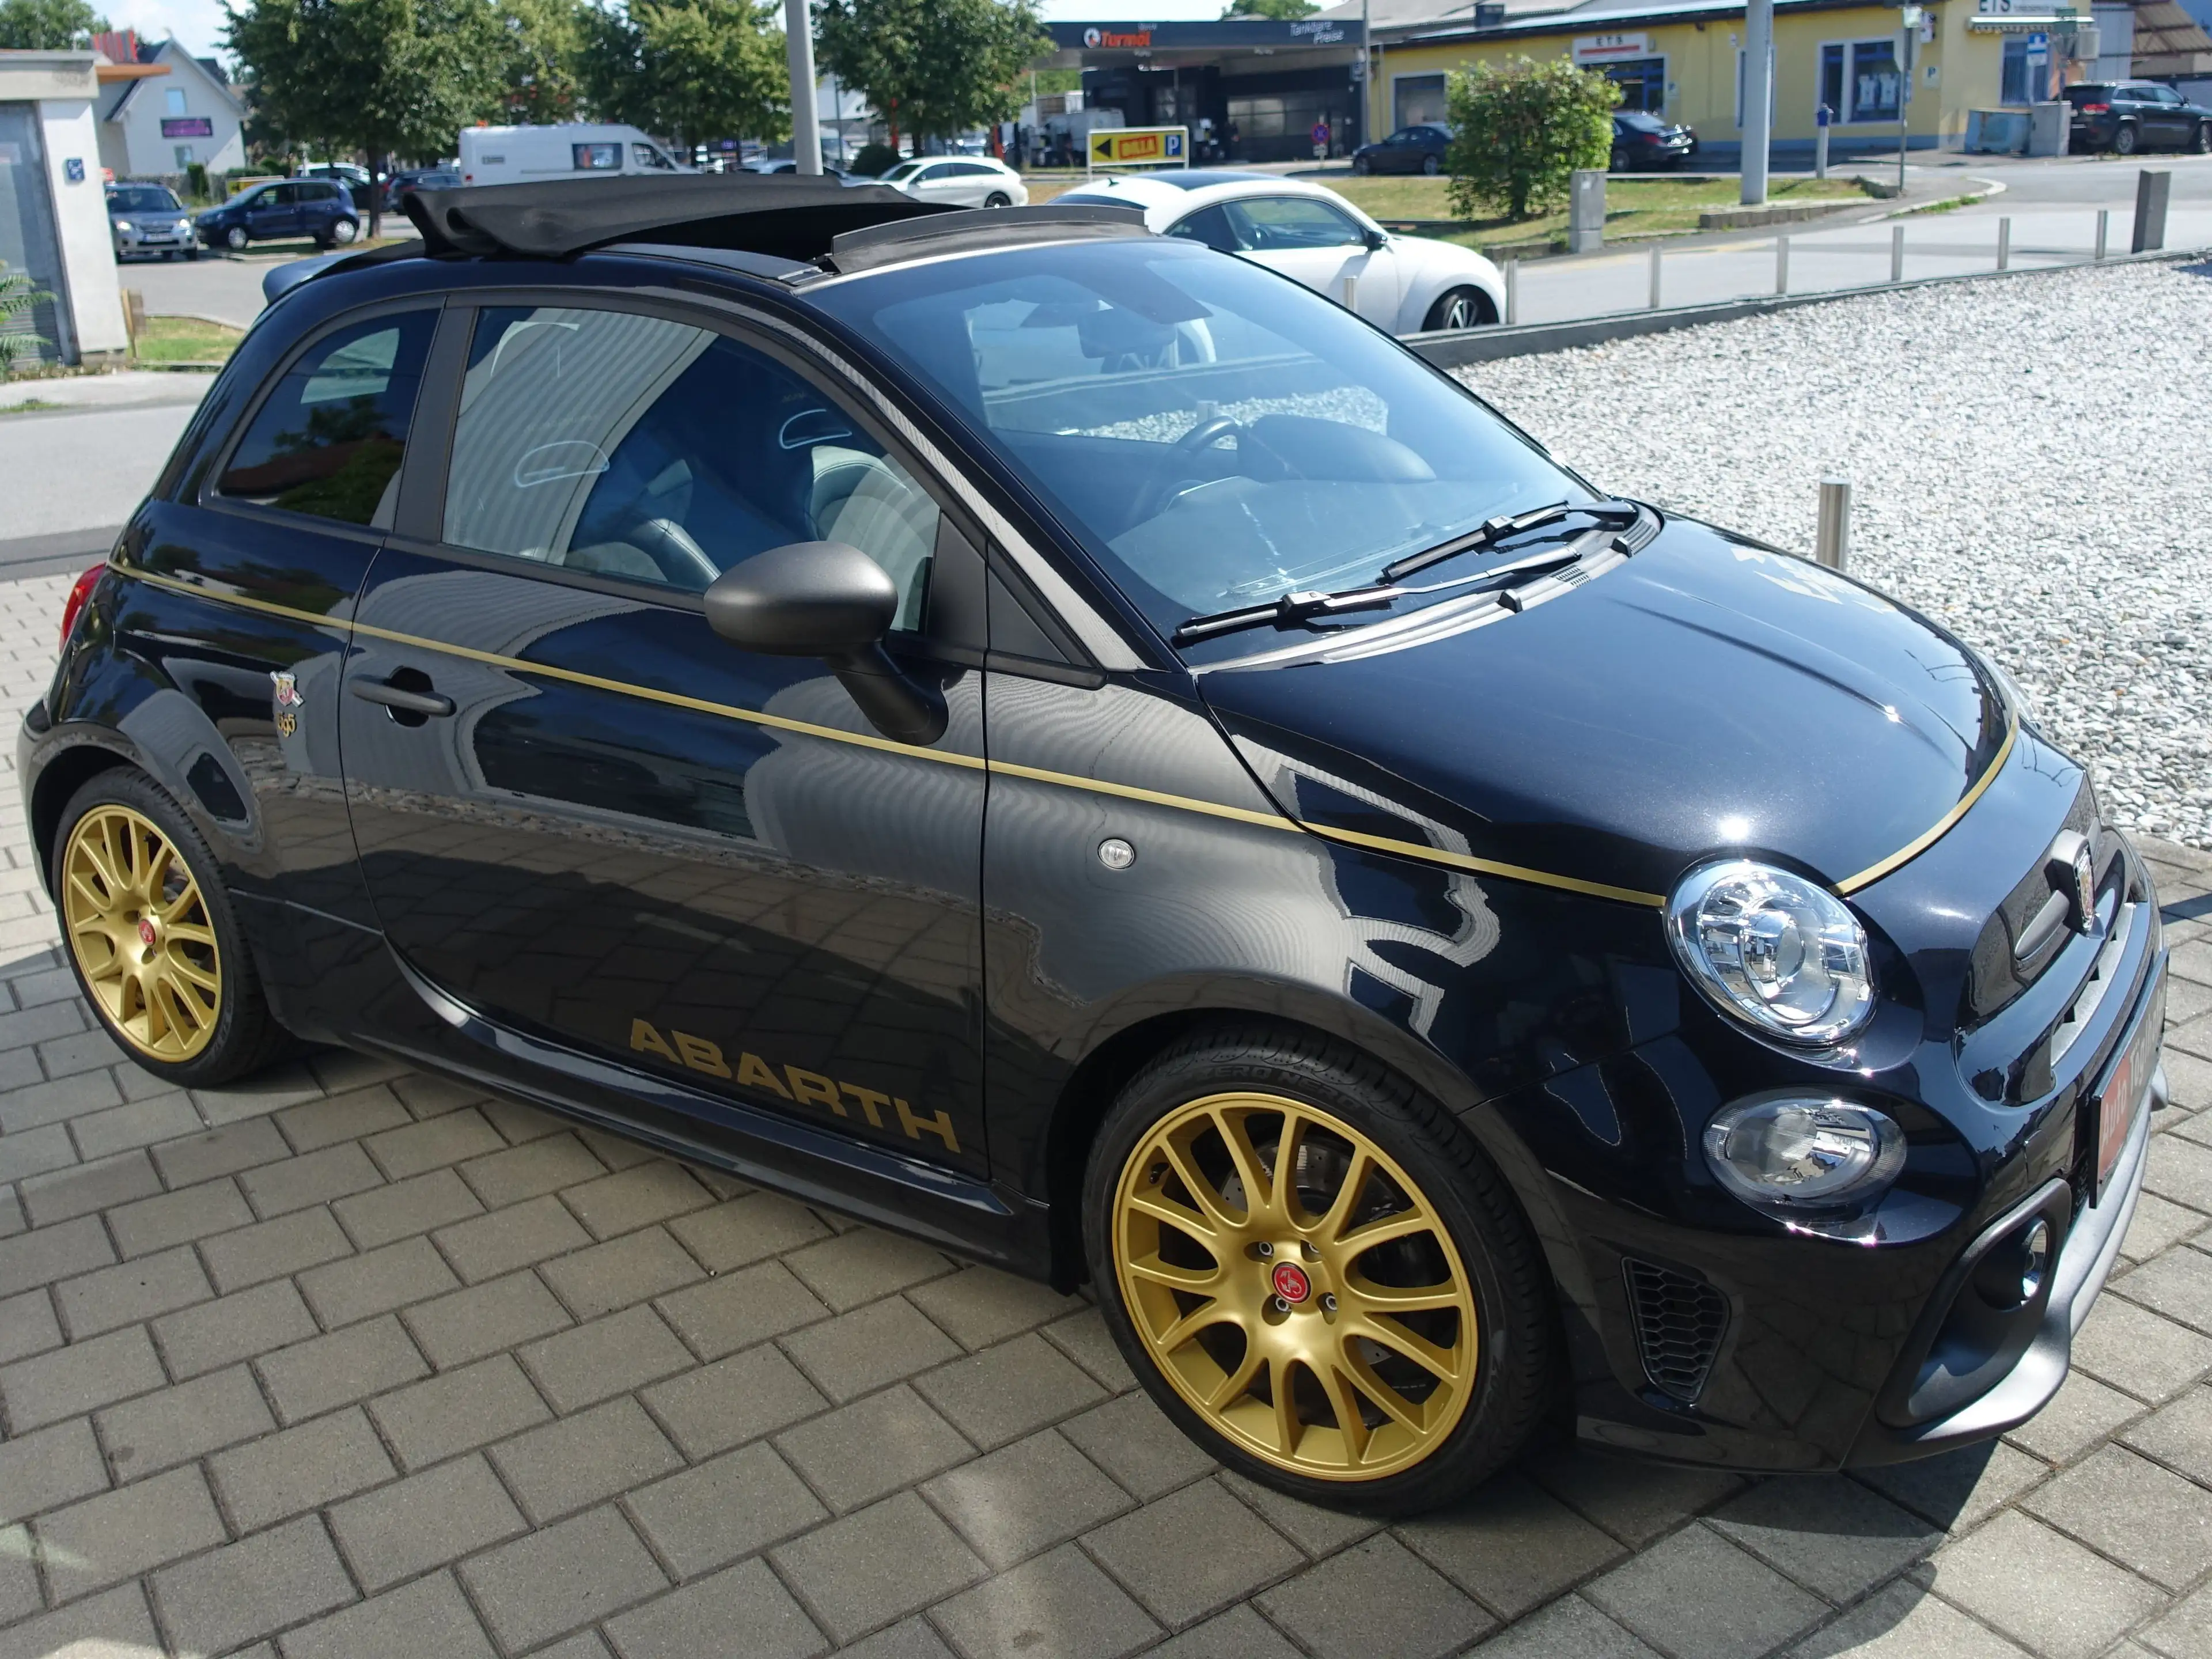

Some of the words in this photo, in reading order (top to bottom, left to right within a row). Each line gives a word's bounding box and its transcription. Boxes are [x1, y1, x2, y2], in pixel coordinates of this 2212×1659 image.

[1167, 135, 1179, 156] P
[630, 1017, 961, 1154] ABARTH
[2101, 1079, 2127, 1154] Auto
